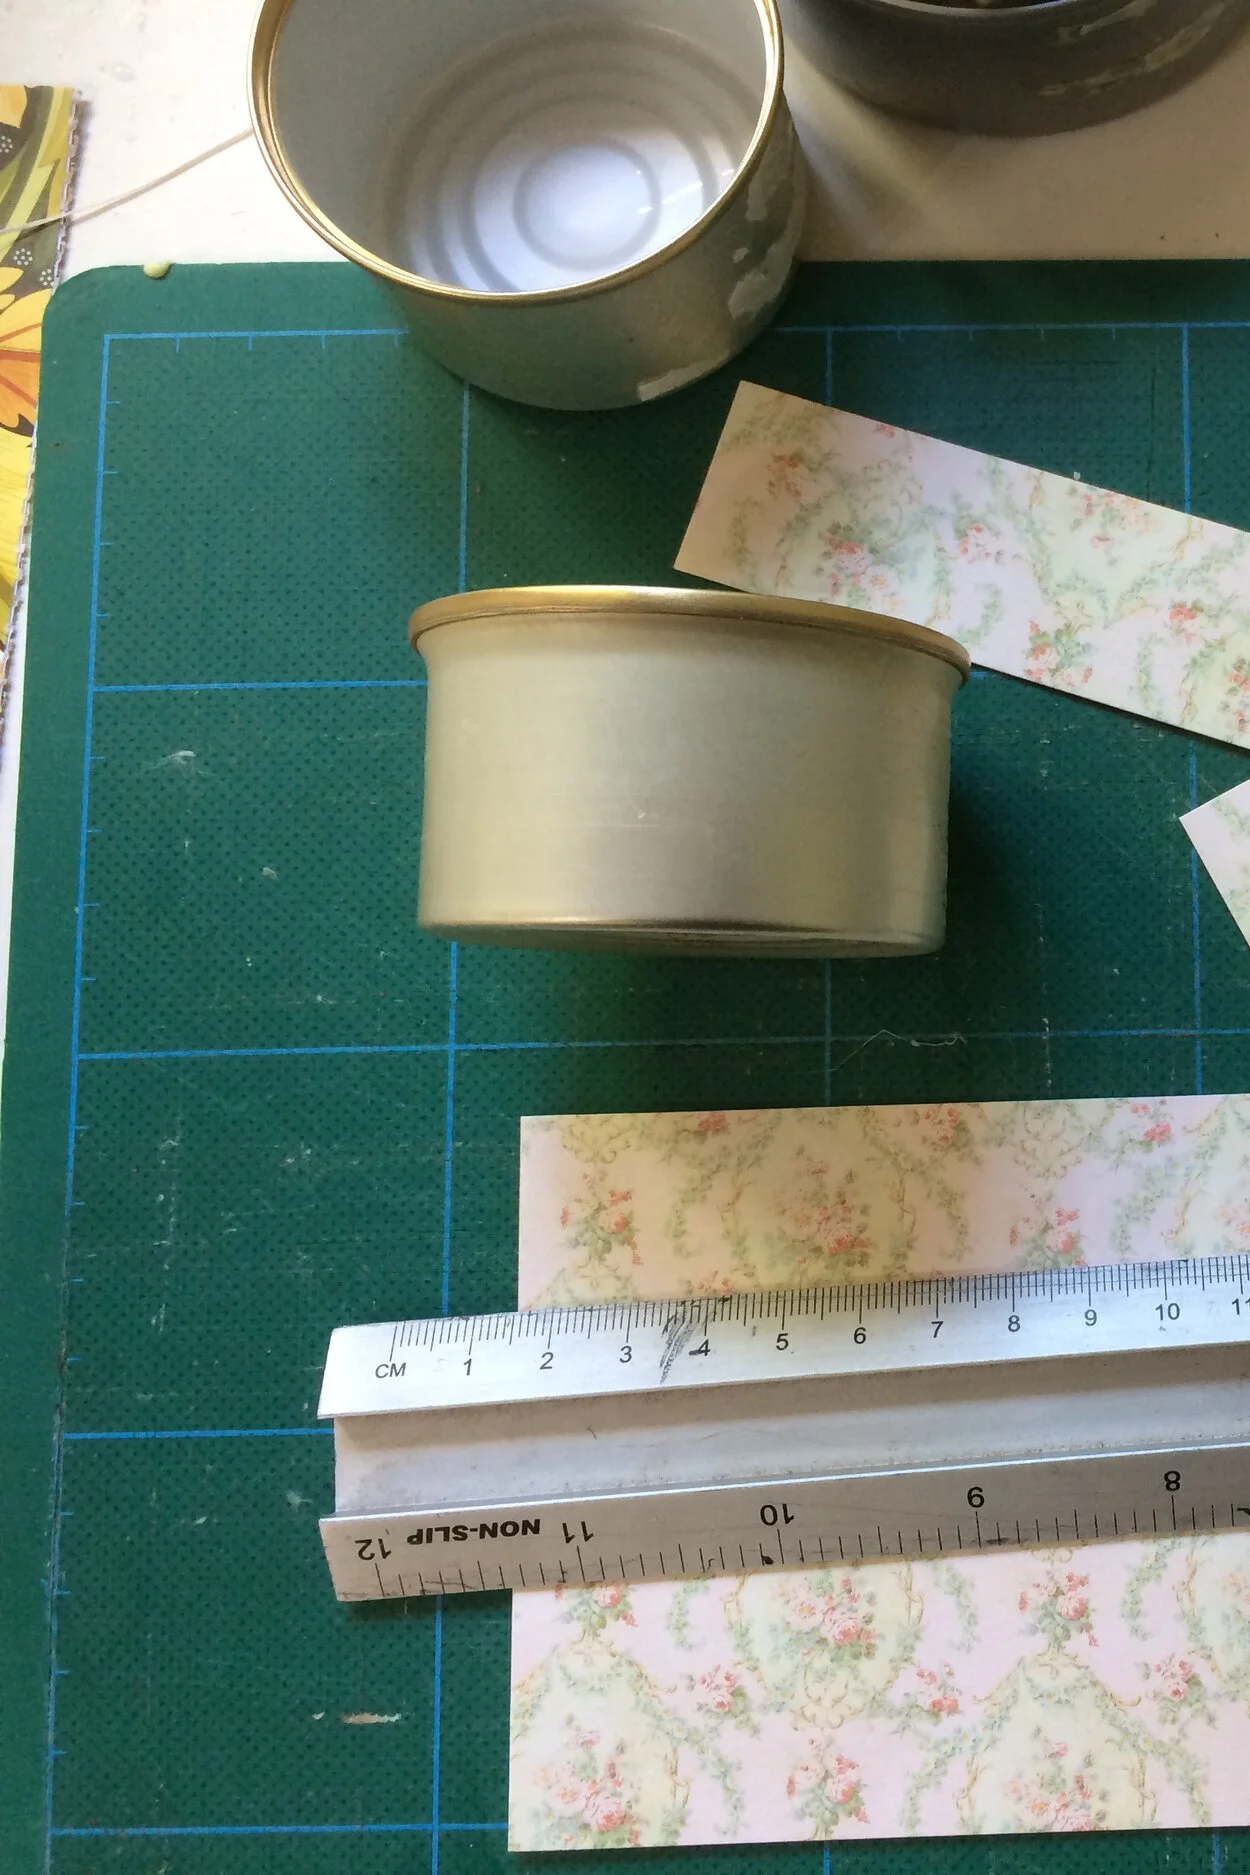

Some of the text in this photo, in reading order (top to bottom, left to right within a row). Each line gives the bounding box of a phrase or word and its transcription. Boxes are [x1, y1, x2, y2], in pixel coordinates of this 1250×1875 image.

[375, 1362, 407, 1379] CM
[463, 1358, 473, 1376] 1
[539, 1351, 554, 1370] 2
[619, 1345, 633, 1364] 3
[693, 1338, 711, 1357] 4
[776, 1332, 789, 1351] 5
[853, 1326, 867, 1345] 6
[930, 1320, 944, 1339] 7
[1007, 1314, 1021, 1333] 8
[1084, 1309, 1098, 1327] 9
[1155, 1302, 1181, 1321] 10
[1163, 1470, 1181, 1492] 8
[966, 1486, 985, 1509] 9
[760, 1503, 795, 1527] 10
[406, 1518, 541, 1545] NON-SLIP
[562, 1520, 594, 1544] 11
[354, 1538, 392, 1561] 12
